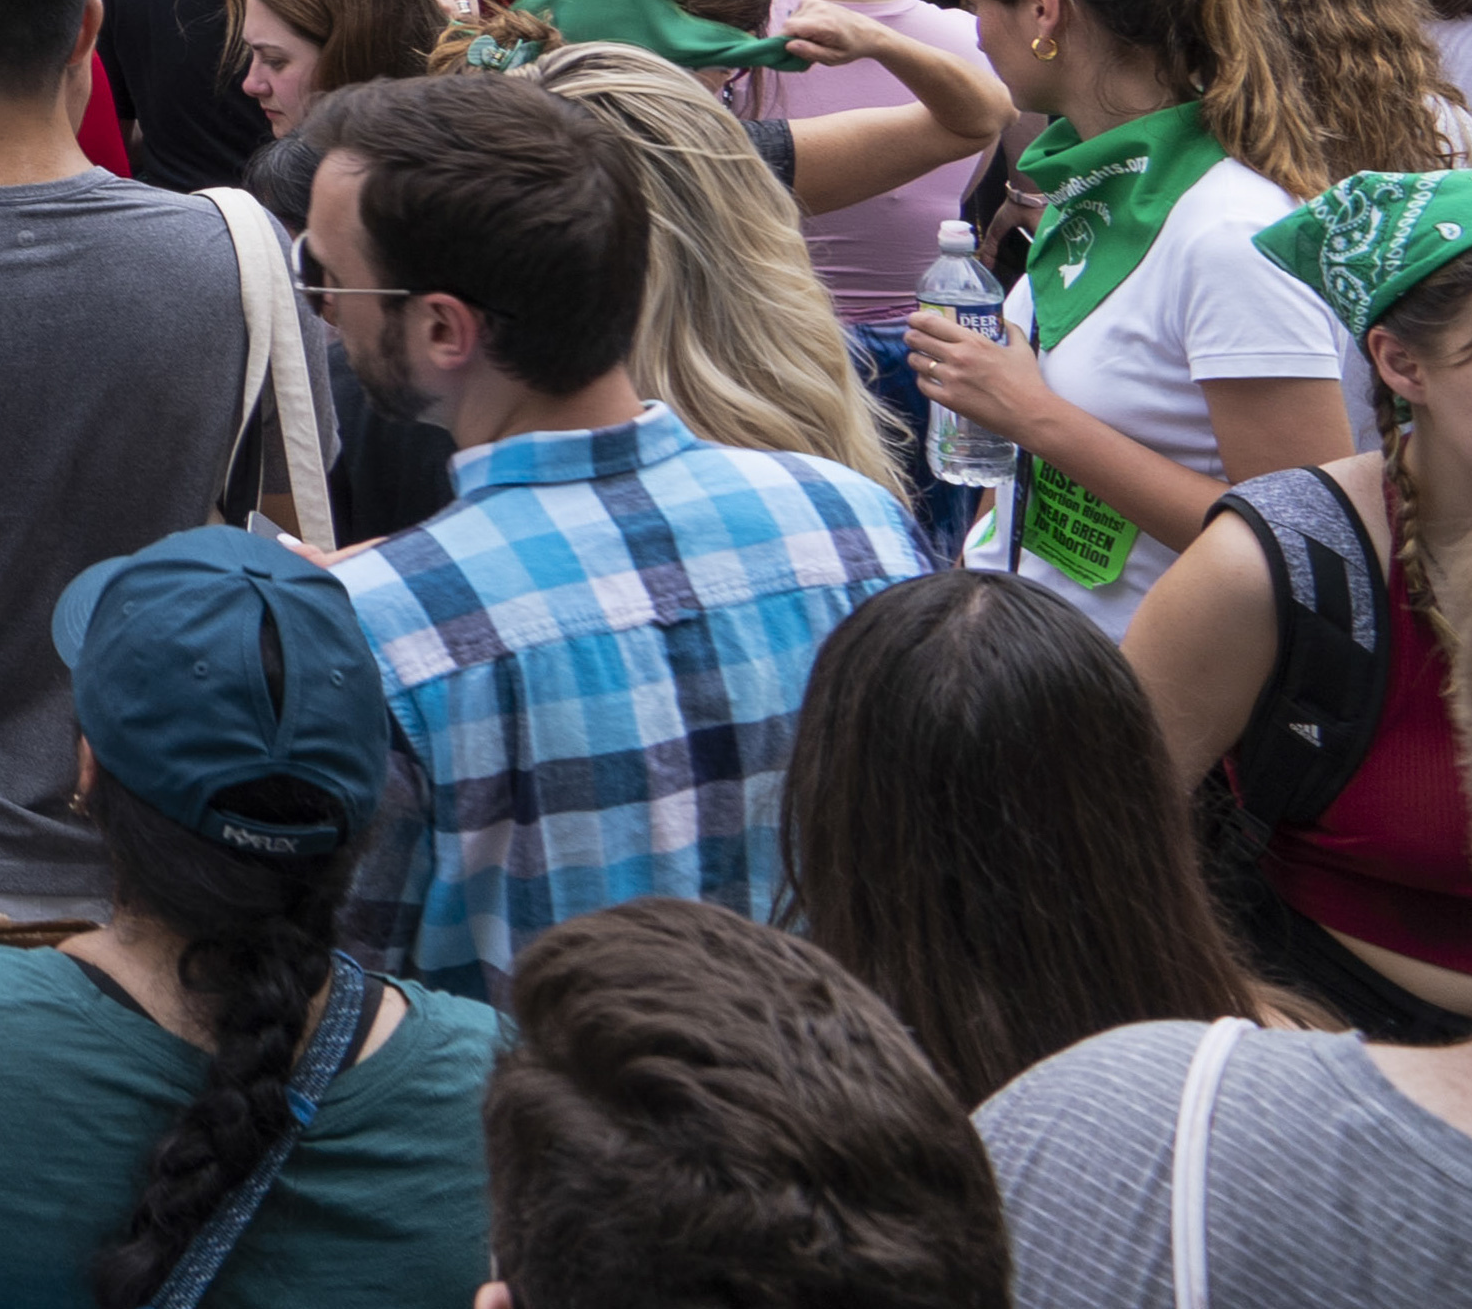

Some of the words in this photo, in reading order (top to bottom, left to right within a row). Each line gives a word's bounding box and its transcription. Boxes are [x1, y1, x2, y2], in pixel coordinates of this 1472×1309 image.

[959, 315, 999, 327] DEER
[1040, 461, 1083, 497] RISE
[1037, 477, 1082, 514] Abortion
[1081, 502, 1126, 534] Rights!
[1039, 500, 1068, 528] WEAR
[1070, 513, 1116, 553] GREEN
[1051, 524, 1111, 569] Abortion
